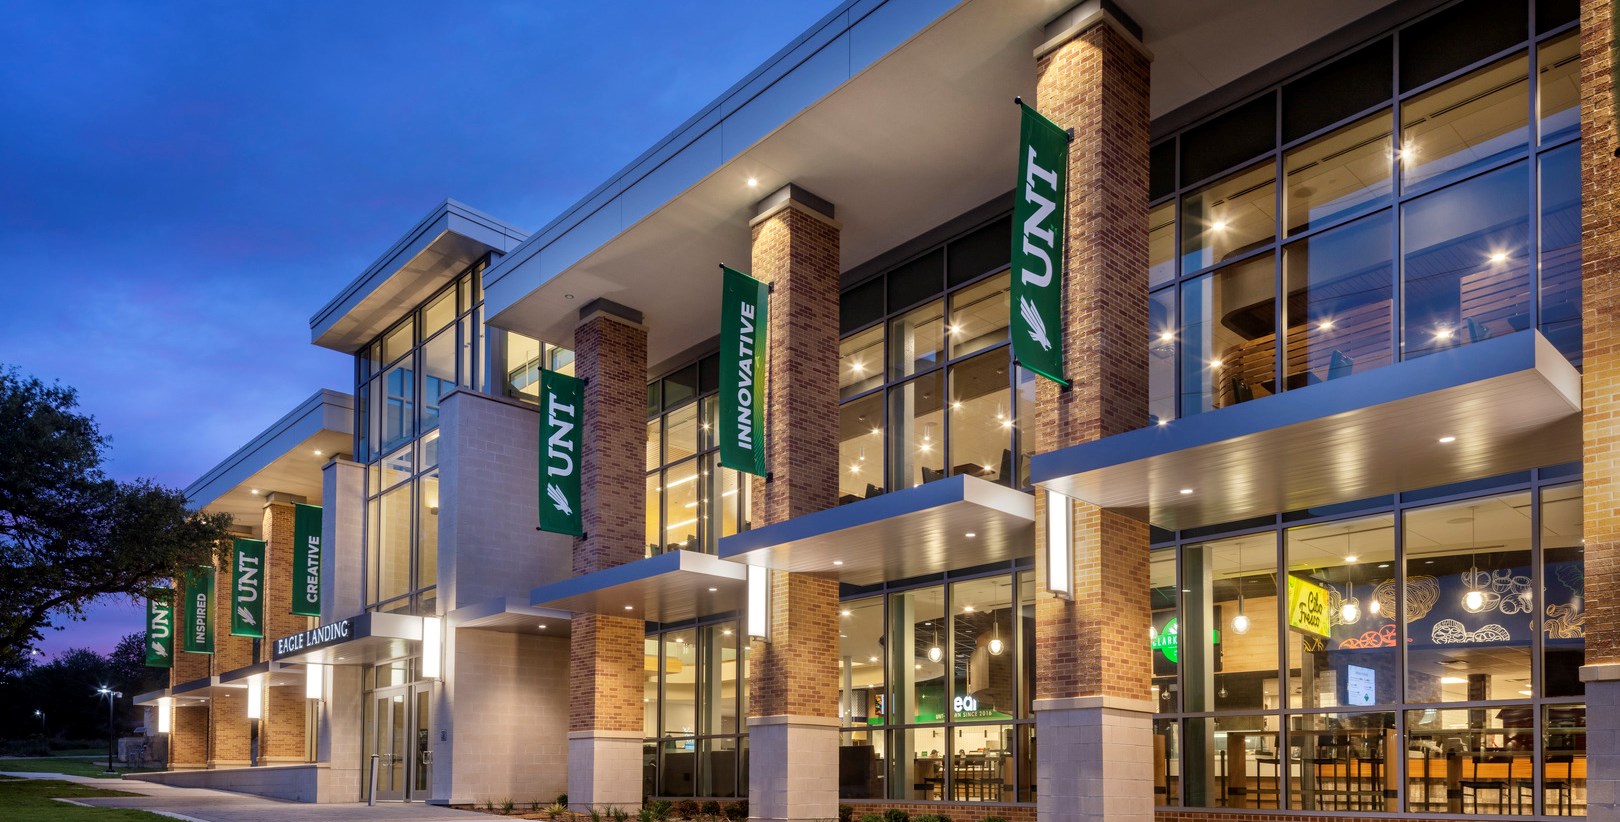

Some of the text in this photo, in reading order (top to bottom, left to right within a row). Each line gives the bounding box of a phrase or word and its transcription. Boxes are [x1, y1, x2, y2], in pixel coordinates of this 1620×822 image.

[1022, 145, 1057, 287] UNT
[737, 301, 754, 449] INNOVATIVE
[548, 392, 575, 476] UNT
[238, 551, 259, 602] UNT
[306, 535, 319, 603] CREATIVE
[196, 593, 206, 643] INSPIRED
[278, 620, 348, 654] EAGLE LANDING
[1298, 601, 1320, 627] Fresco
